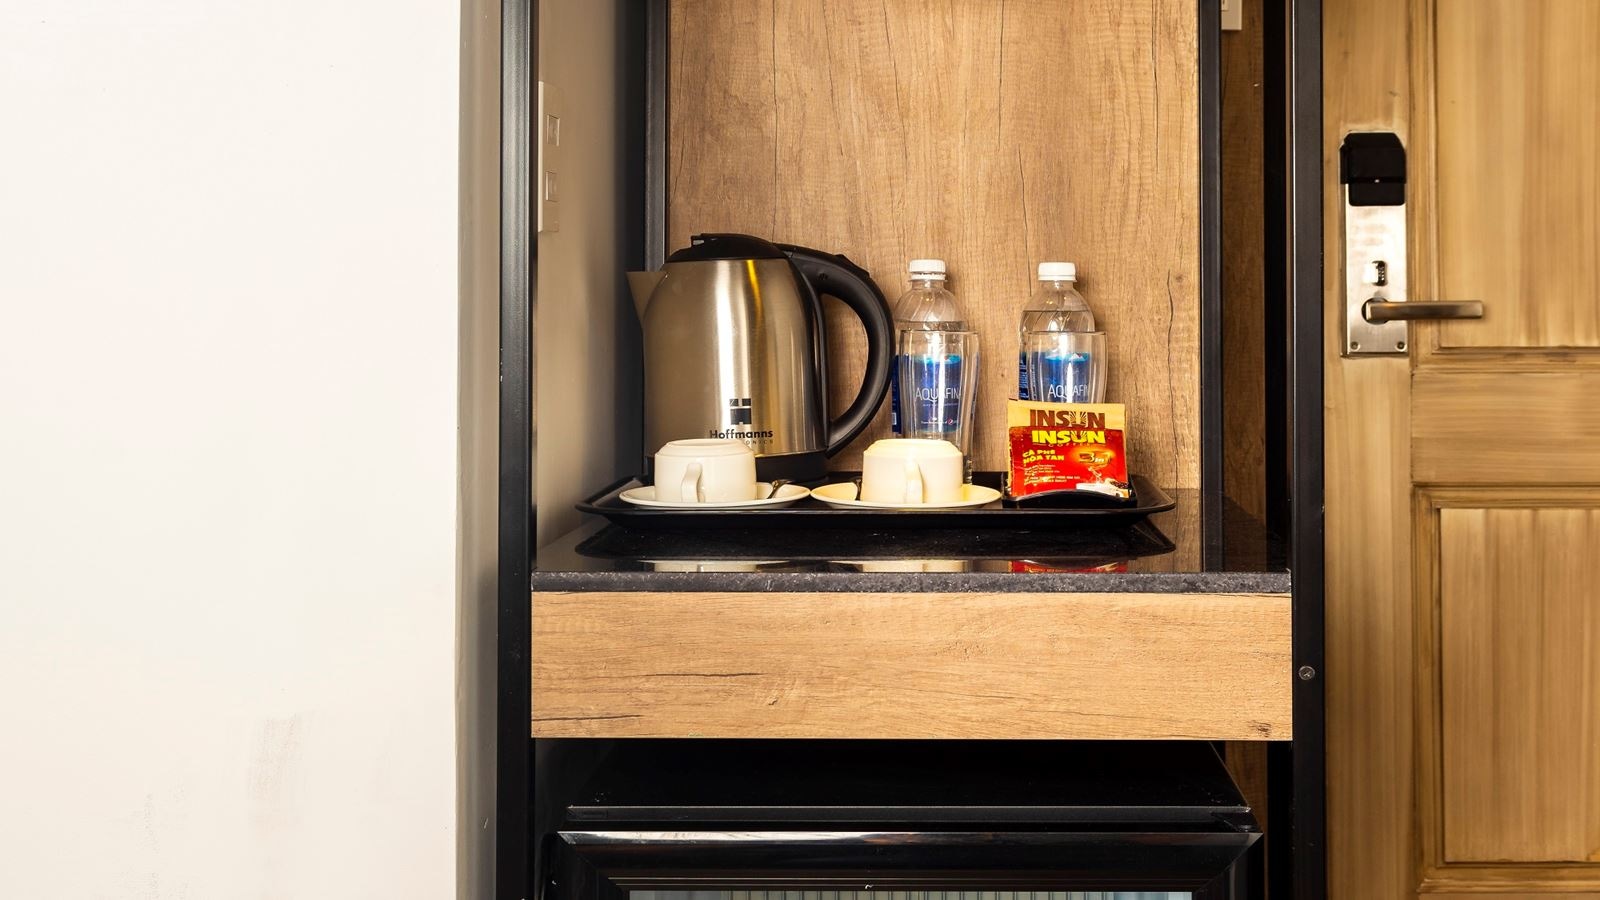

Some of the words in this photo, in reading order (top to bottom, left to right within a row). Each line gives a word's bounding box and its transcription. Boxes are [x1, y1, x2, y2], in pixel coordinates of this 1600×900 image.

[1030, 409, 1106, 428] INSUN
[709, 429, 773, 439] Hoffmanns
[1031, 429, 1106, 444] INSUN
